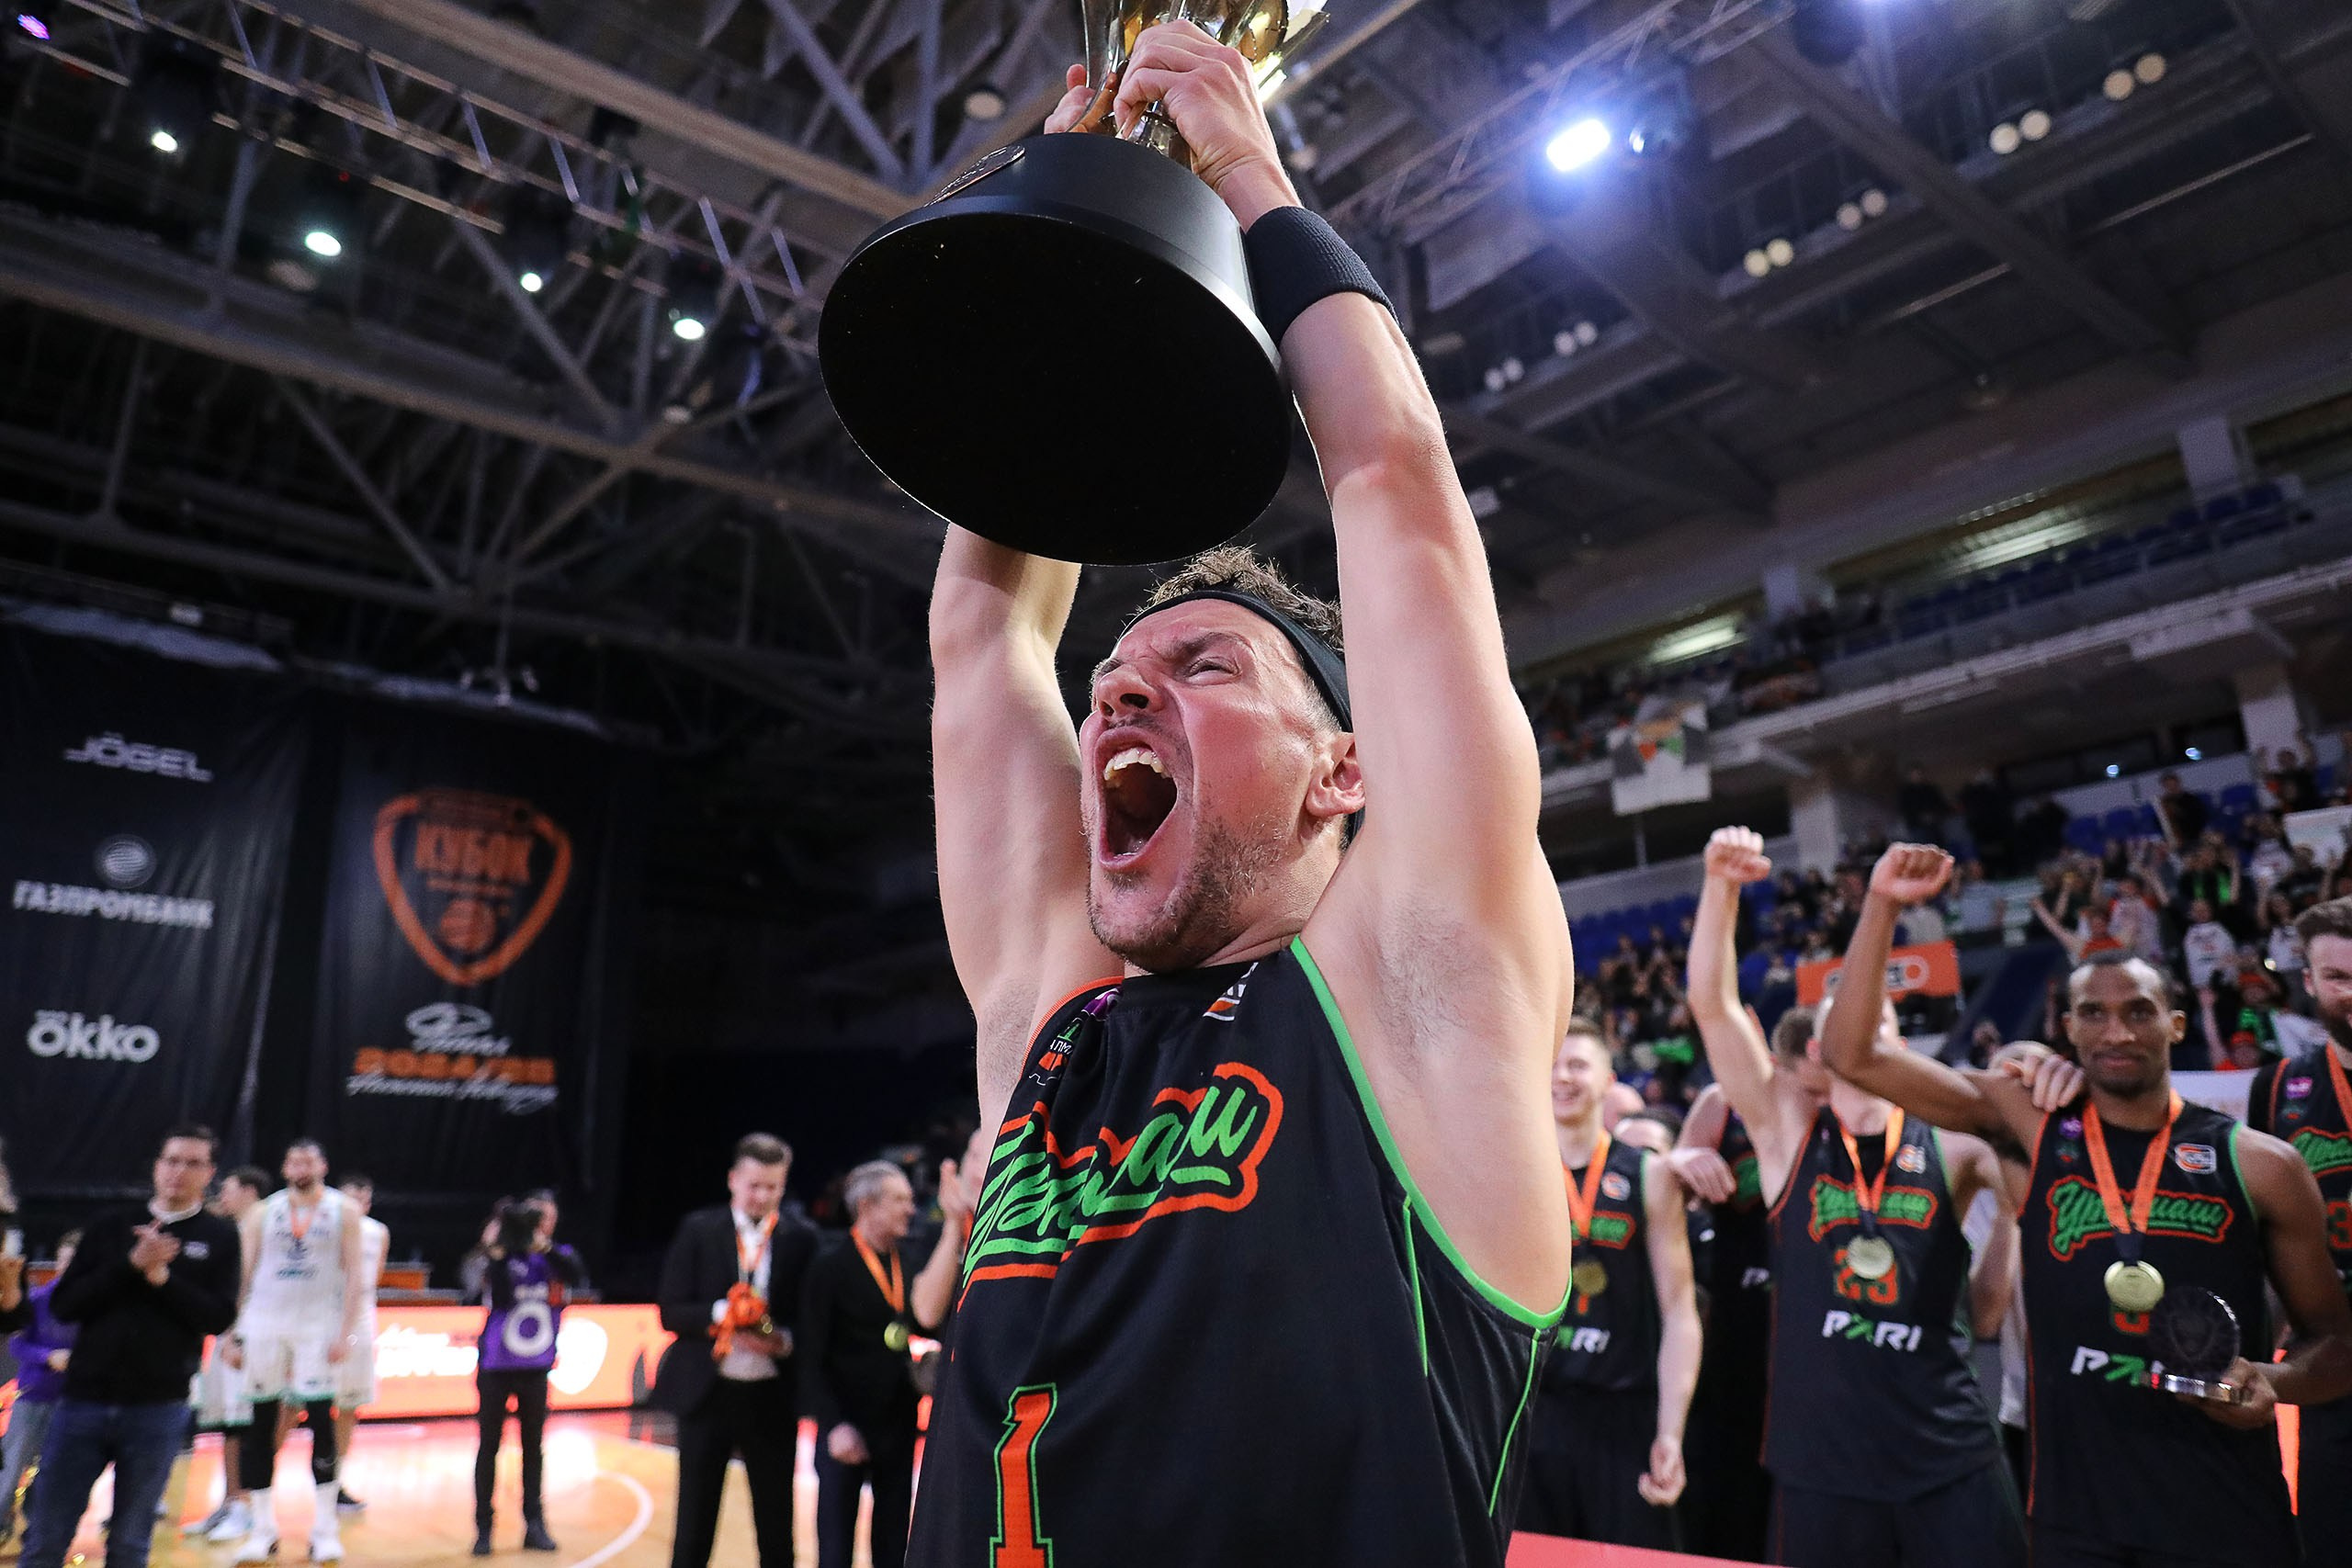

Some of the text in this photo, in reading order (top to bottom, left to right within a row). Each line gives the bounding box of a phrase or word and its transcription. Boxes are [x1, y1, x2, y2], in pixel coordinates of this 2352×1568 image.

[14, 879, 215, 930] ГАЗПРОМБАНК
[1822, 1310, 1922, 1351] PARI
[991, 1383, 1056, 1568] 1
